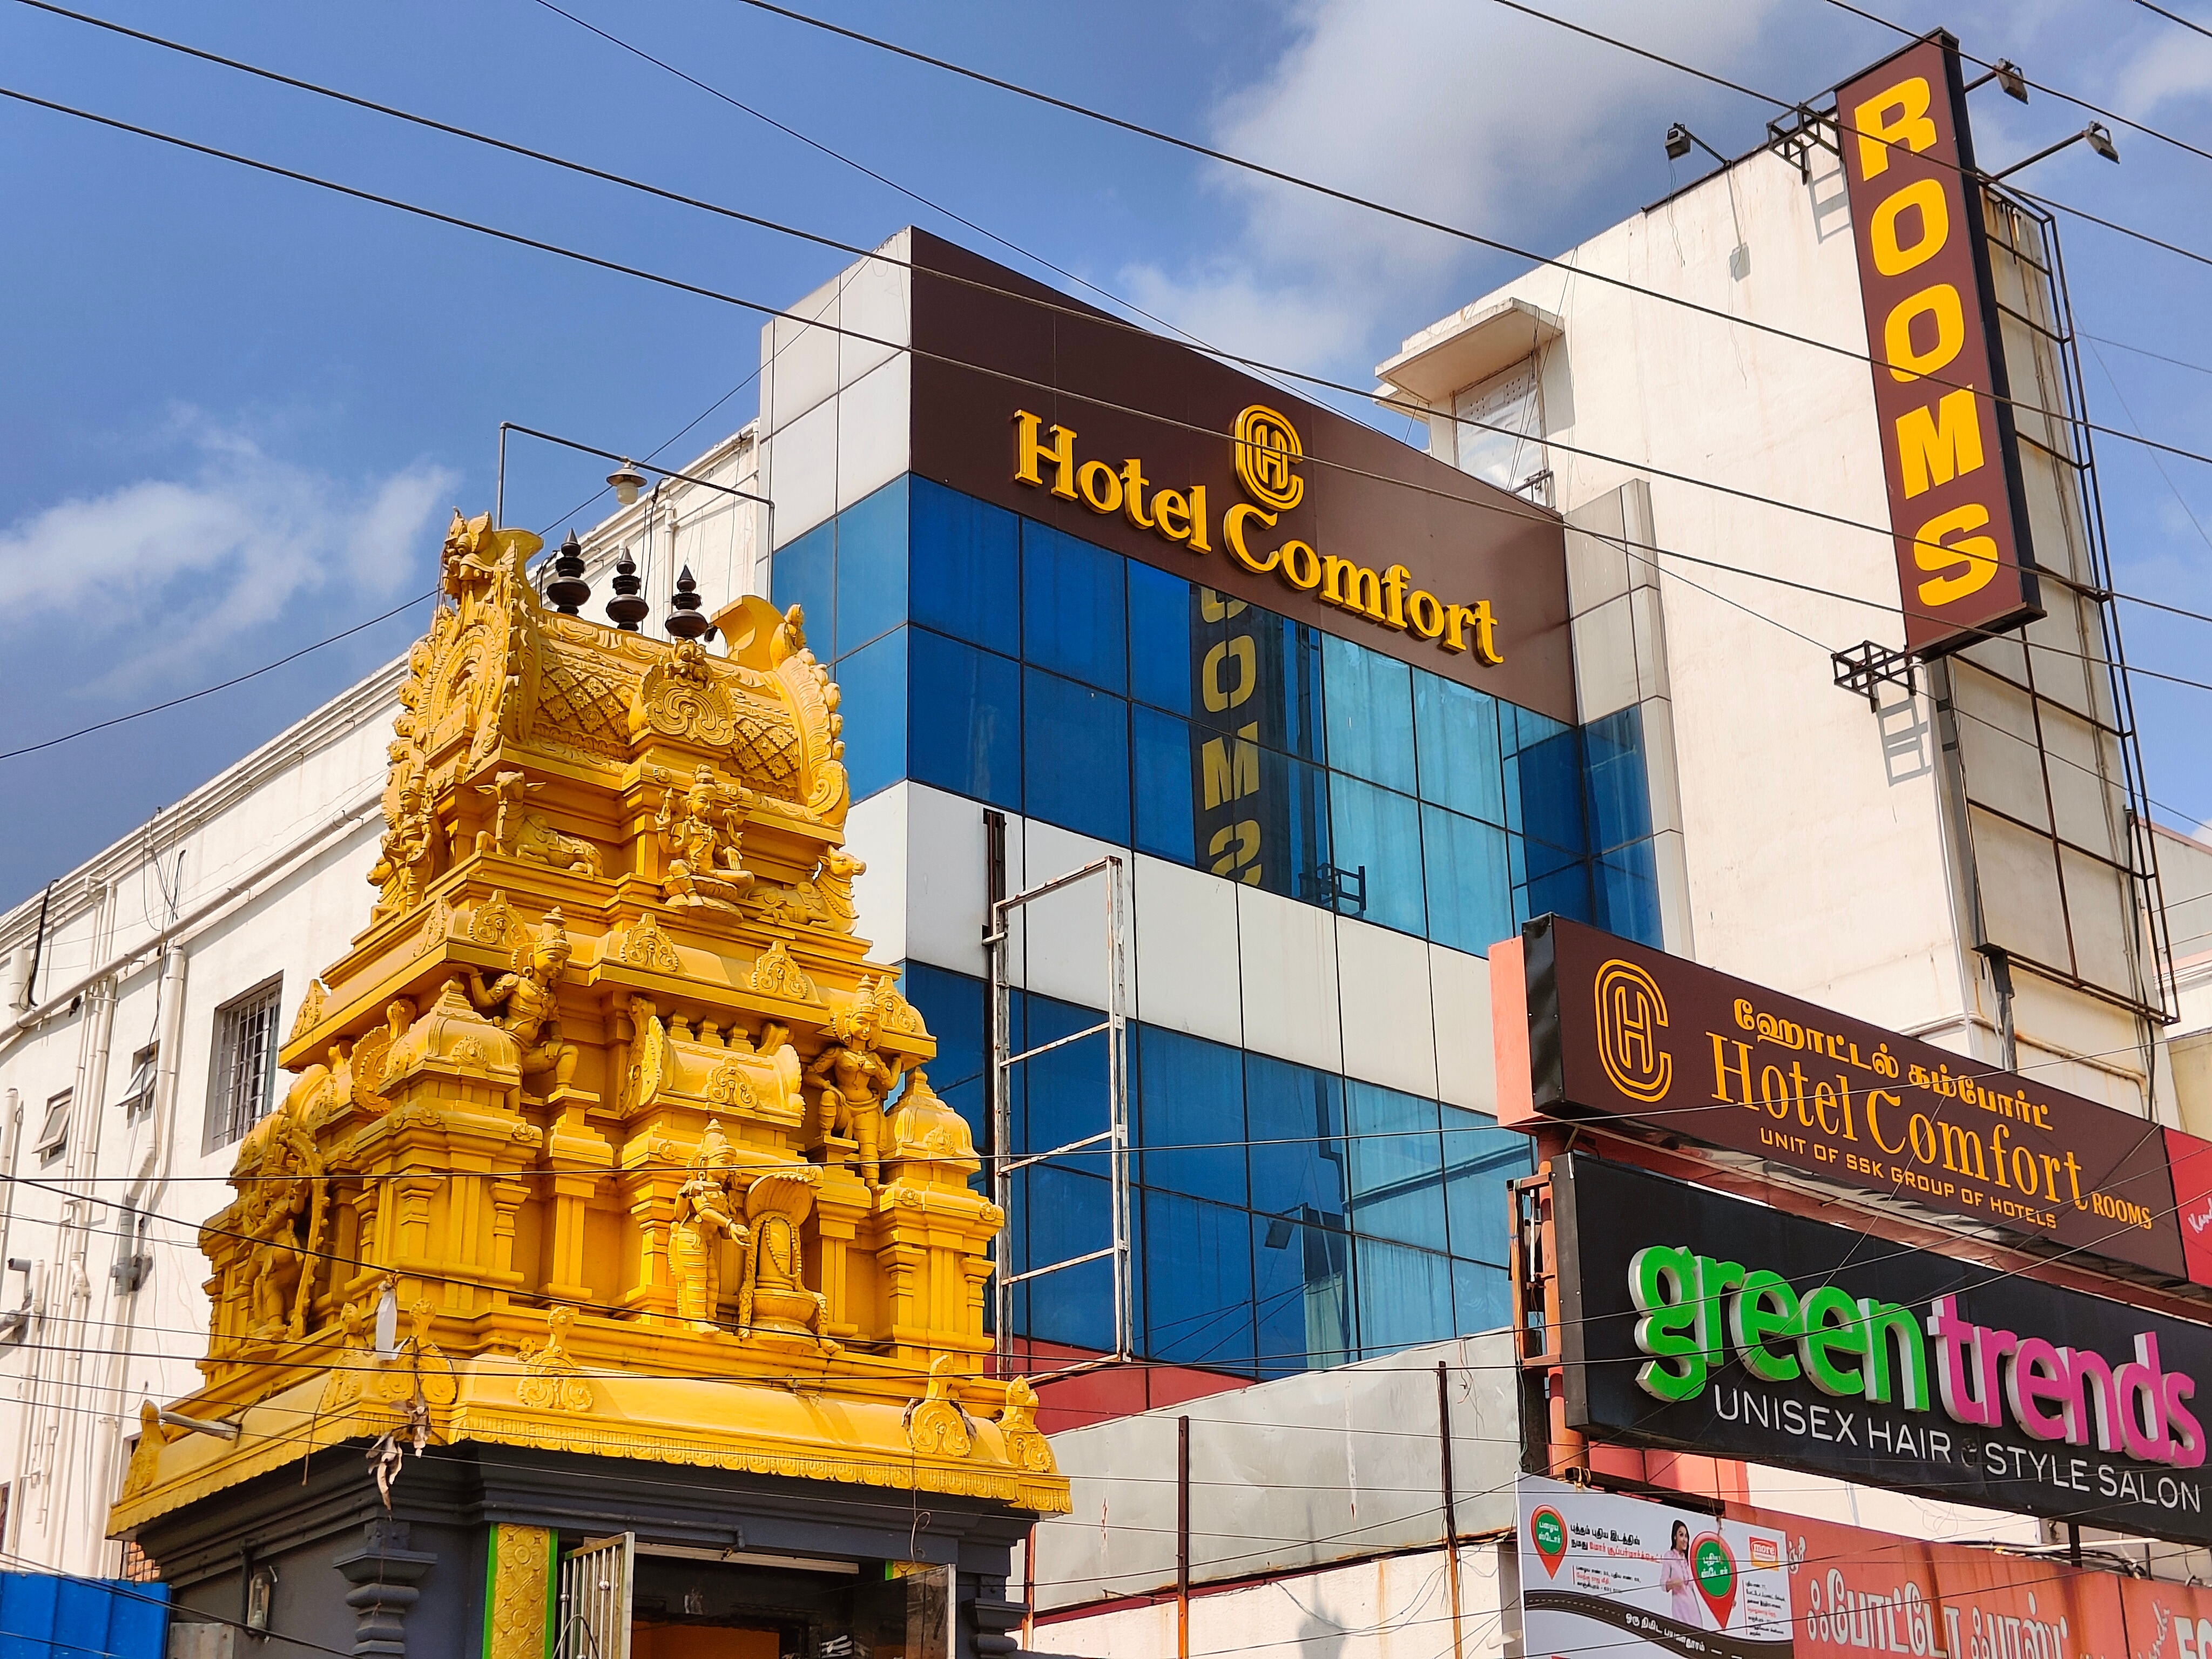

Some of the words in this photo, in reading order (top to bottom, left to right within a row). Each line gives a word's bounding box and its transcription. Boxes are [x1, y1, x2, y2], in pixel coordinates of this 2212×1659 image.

[1854, 77, 1999, 606] ROOMS
[1014, 409, 1212, 554] Hotel
[1223, 503, 1505, 665] Comfort
[1706, 1031, 1858, 1141] Hotel
[1866, 1089, 2088, 1211] Comfort
[1734, 998, 1899, 1079] ஹோட்டல்
[1908, 1062, 2053, 1131] கம்போர்ட்
[1760, 1128, 1807, 1155] UNIT
[1813, 1143, 1839, 1163] OF
[1846, 1152, 1885, 1178] SSK
[1891, 1166, 1955, 1197] GROUP
[1961, 1188, 1984, 1207] OF
[1991, 1197, 2056, 1229] HOTELS
[2092, 1191, 2152, 1230] ROOMS
[1714, 1384, 1858, 1446] UNISEX
[1867, 1417, 1952, 1464] HAIR
[1985, 1441, 2090, 1492] STYLE
[2098, 1465, 2201, 1513] SALON
[1592, 1528, 1608, 1540] புதிய
[1753, 1543, 1775, 1555] more
[1626, 1613, 1640, 1627] ஒரு
